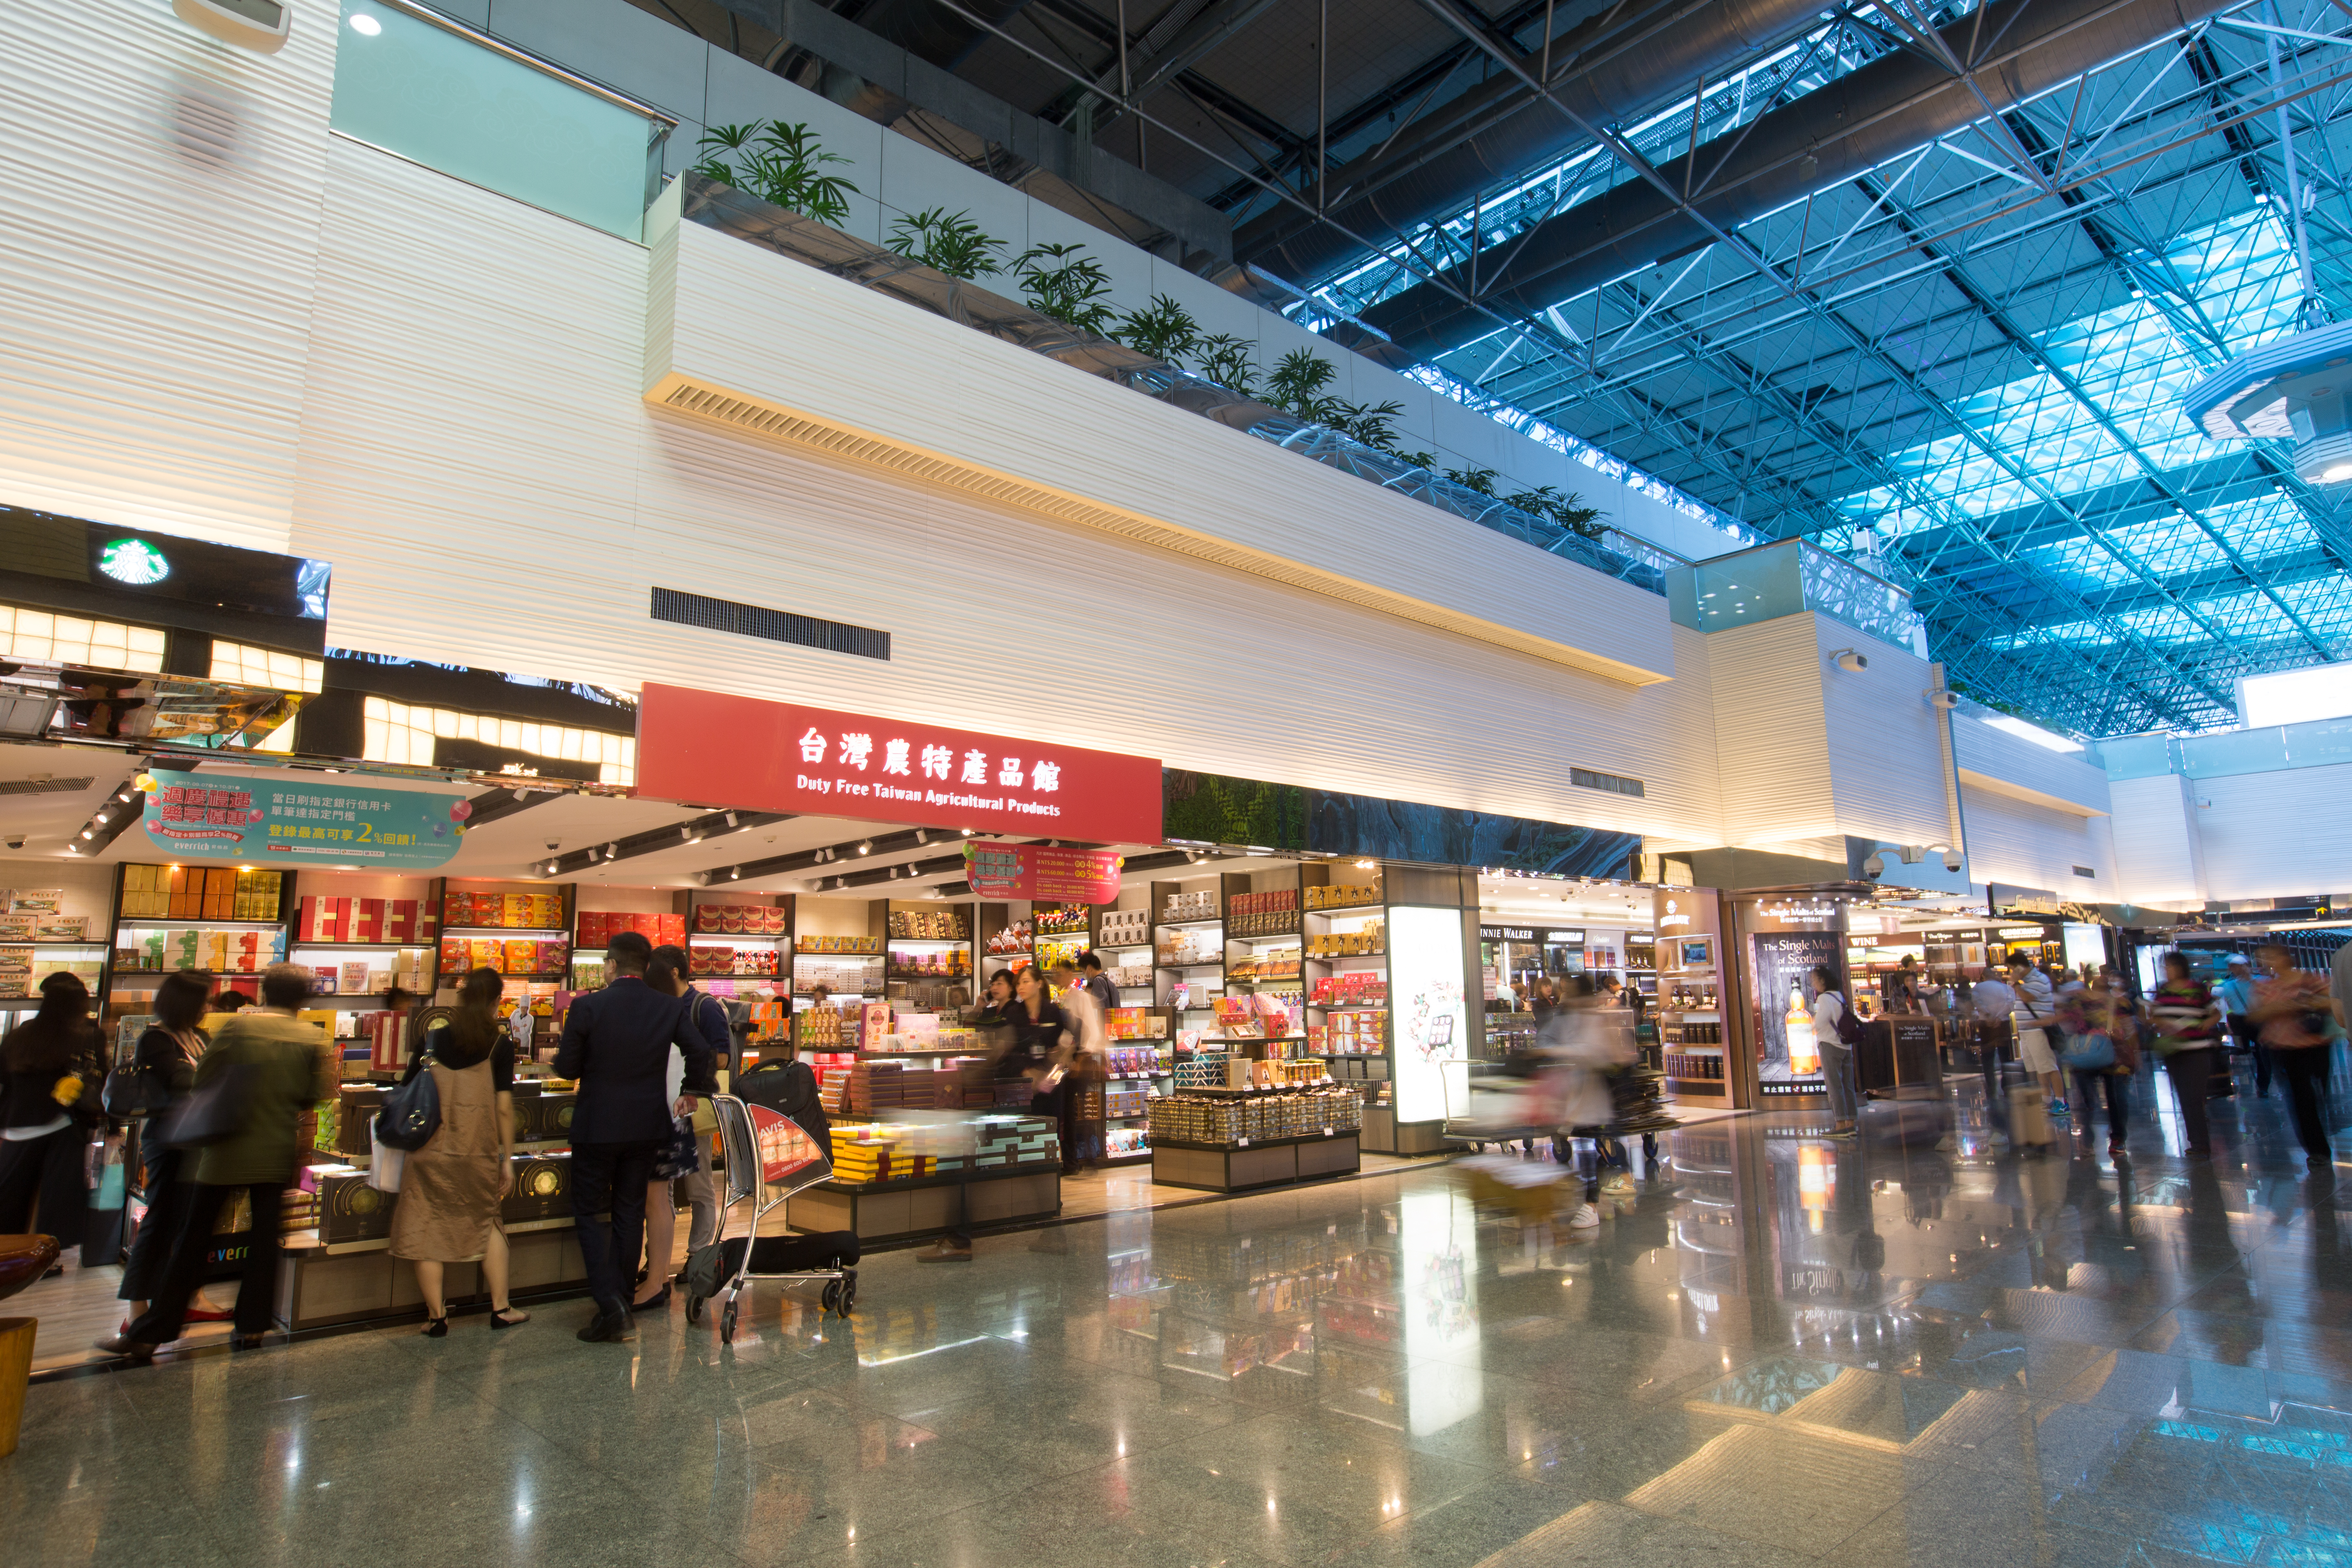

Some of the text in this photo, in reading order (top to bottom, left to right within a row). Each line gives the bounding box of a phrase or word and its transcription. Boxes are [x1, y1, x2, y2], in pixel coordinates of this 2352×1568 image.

[799, 727, 1060, 792] 台灣農特產品館
[162, 786, 251, 809] 週慶禮遇
[272, 793, 392, 812] 當日刷指定銀行信用卡
[797, 775, 1060, 816] Duty Free Taiwan Agricultural Products
[160, 805, 247, 826] 樂享優惠
[271, 806, 356, 821] 單筆達指定門檻
[174, 842, 209, 851] everrich
[1769, 908, 1790, 918] Single
[1791, 908, 1809, 916] Malts
[1480, 928, 1533, 939] NNIE WALKER
[1779, 940, 1810, 954] Single
[1812, 939, 1835, 950] Malts
[1850, 936, 1878, 947] WINE
[1788, 953, 1828, 964] Scotland
[760, 1120, 785, 1139] AVIS
[782, 1163, 793, 1172] 0800
[207, 1246, 250, 1263] everr
